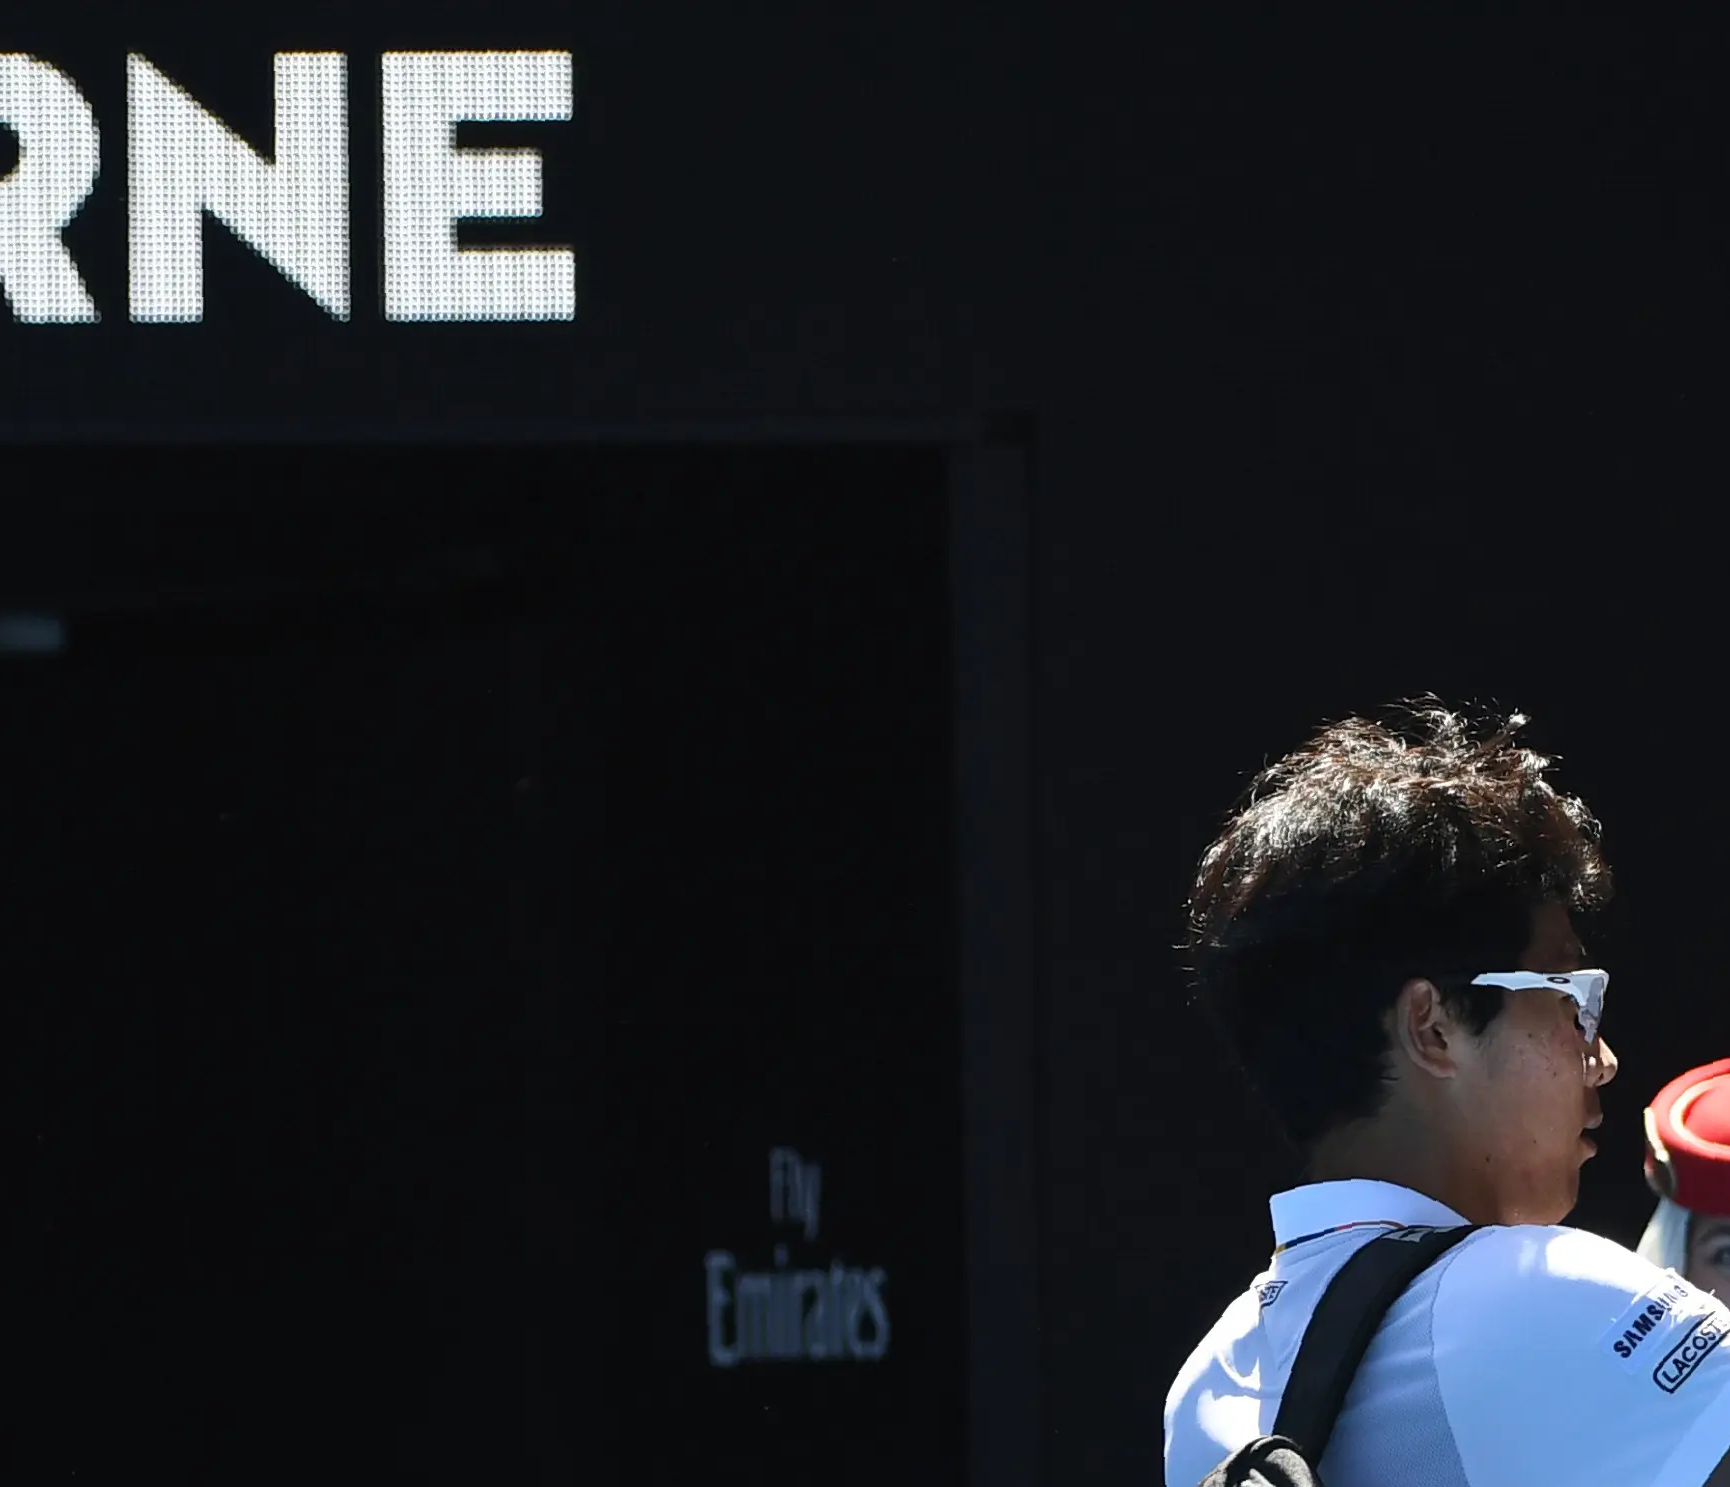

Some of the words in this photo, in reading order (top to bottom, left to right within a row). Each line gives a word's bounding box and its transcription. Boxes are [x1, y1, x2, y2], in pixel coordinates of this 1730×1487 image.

[769, 1145, 821, 1242] Fly
[704, 1244, 890, 1367] Emirates
[1613, 1284, 1689, 1359] SAMSUNG
